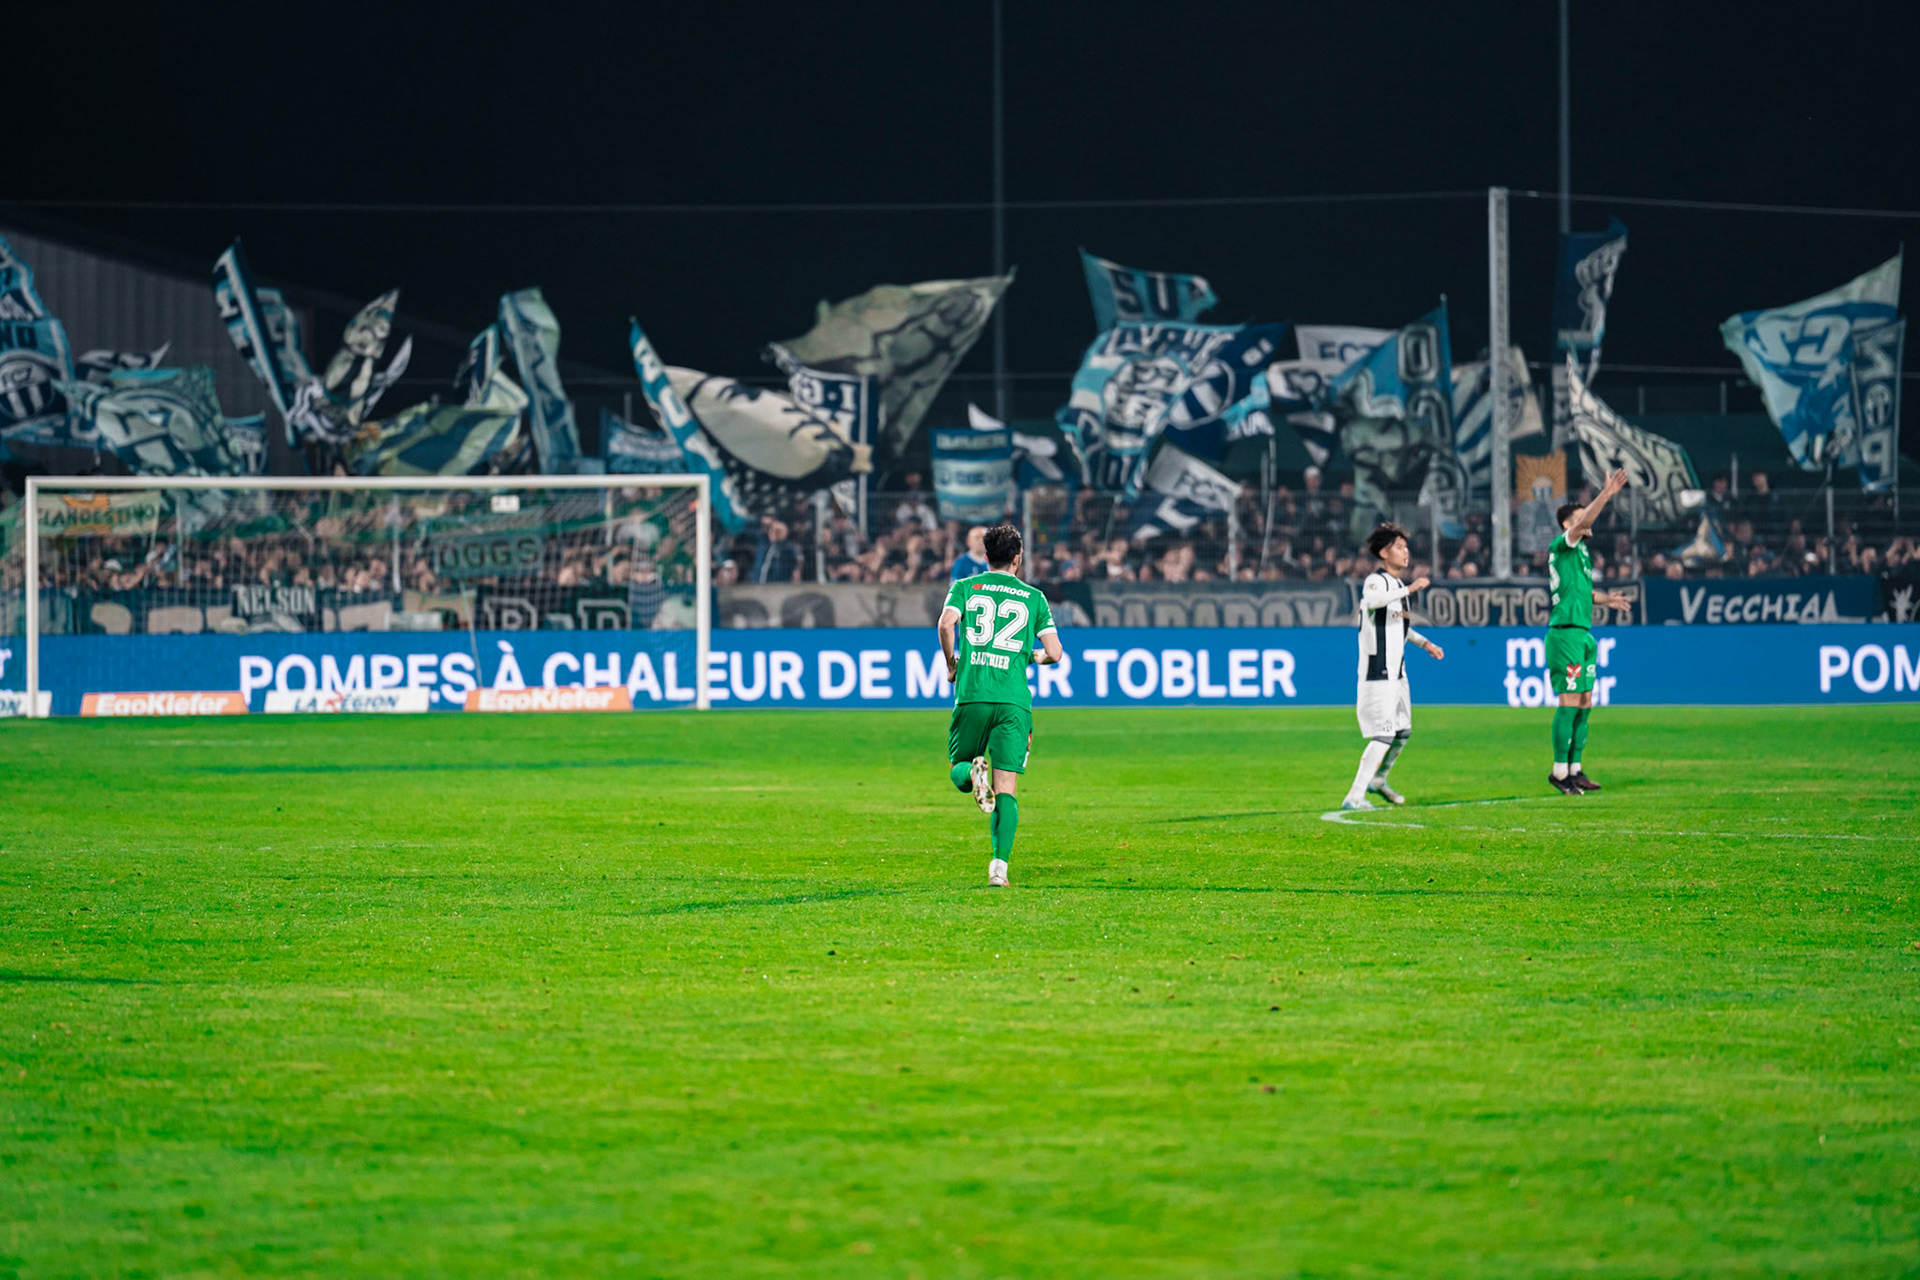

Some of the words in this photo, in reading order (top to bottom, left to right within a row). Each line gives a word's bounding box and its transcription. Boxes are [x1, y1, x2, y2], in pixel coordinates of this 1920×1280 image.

[233, 586, 317, 615] NELSON
[965, 594, 1029, 653] 32
[239, 653, 478, 706] POMPES
[493, 640, 526, 692] À
[542, 651, 804, 702] CHALEUR
[817, 650, 892, 701] DE
[1082, 648, 1297, 699] TOBLER
[970, 651, 1010, 670] SAUTHIER
[478, 690, 614, 711] EgoKiefer
